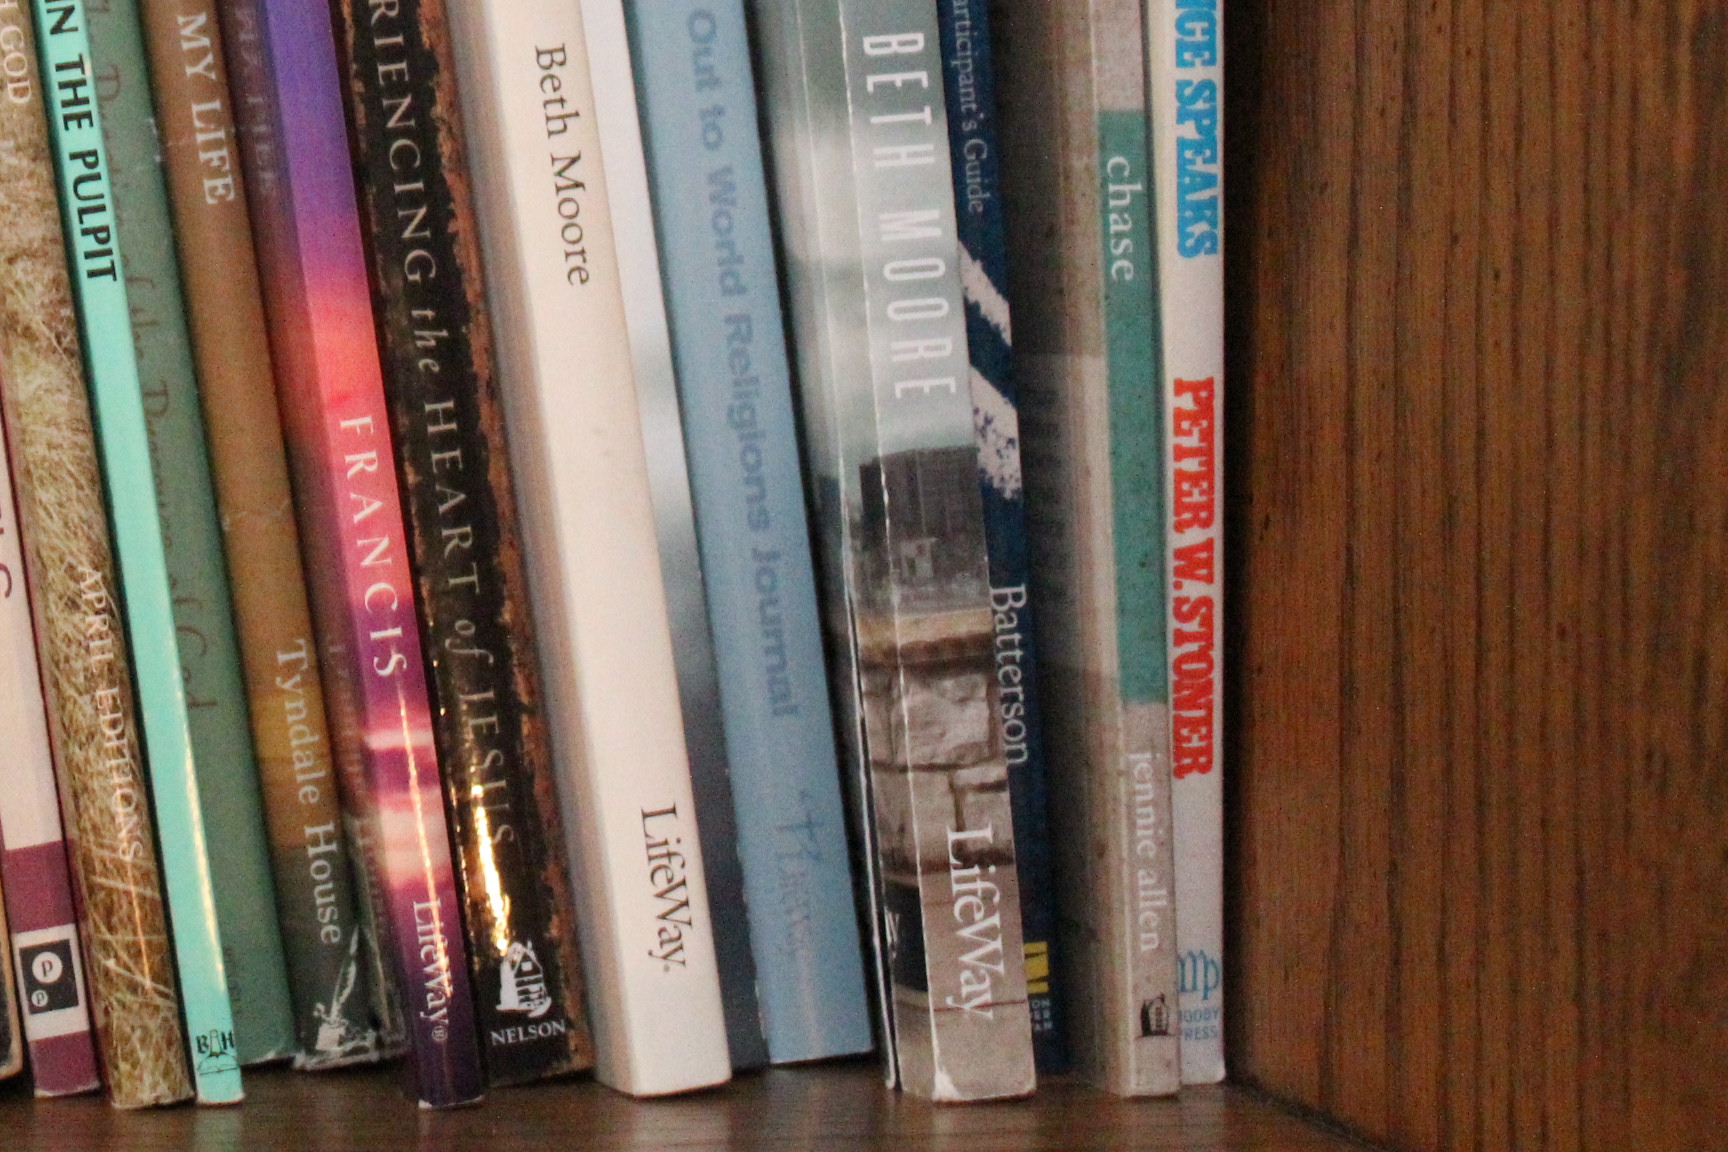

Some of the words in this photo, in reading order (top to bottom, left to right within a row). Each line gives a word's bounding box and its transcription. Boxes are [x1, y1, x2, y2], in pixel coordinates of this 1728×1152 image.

[0, 24, 33, 105] GOD
[54, 52, 95, 132] THE
[177, 13, 217, 81] MY
[535, 43, 580, 140] Beth
[687, 9, 724, 94] Out
[863, 32, 937, 167] BETH
[191, 99, 236, 205] LIFE
[698, 105, 728, 152] to
[964, 138, 992, 215] Guide
[1174, 78, 1218, 259] SPEAKS
[68, 149, 119, 283] PULPIT
[551, 150, 592, 287] Moore
[706, 165, 747, 298] World
[1106, 156, 1142, 281] chase
[409, 307, 451, 374] the
[878, 208, 957, 400] MOORE
[724, 312, 771, 534] Religions
[1172, 376, 1215, 534] PETER
[338, 414, 408, 678] FRANCIS
[423, 400, 481, 595] HEART
[77, 567, 115, 676] APRIL
[443, 618, 494, 670] of
[747, 549, 799, 718] Journal
[989, 583, 1029, 766] Batterson
[1172, 593, 1215, 780] STONER
[94, 687, 146, 860] EDITIONS
[276, 638, 325, 805] Tyndale
[303, 822, 343, 946] House
[1125, 750, 1165, 856] jennie
[639, 801, 692, 969] LifeWay
[945, 824, 1007, 1021] LifeWay
[1135, 870, 1168, 951] allen
[489, 1019, 566, 1047] NELSON
